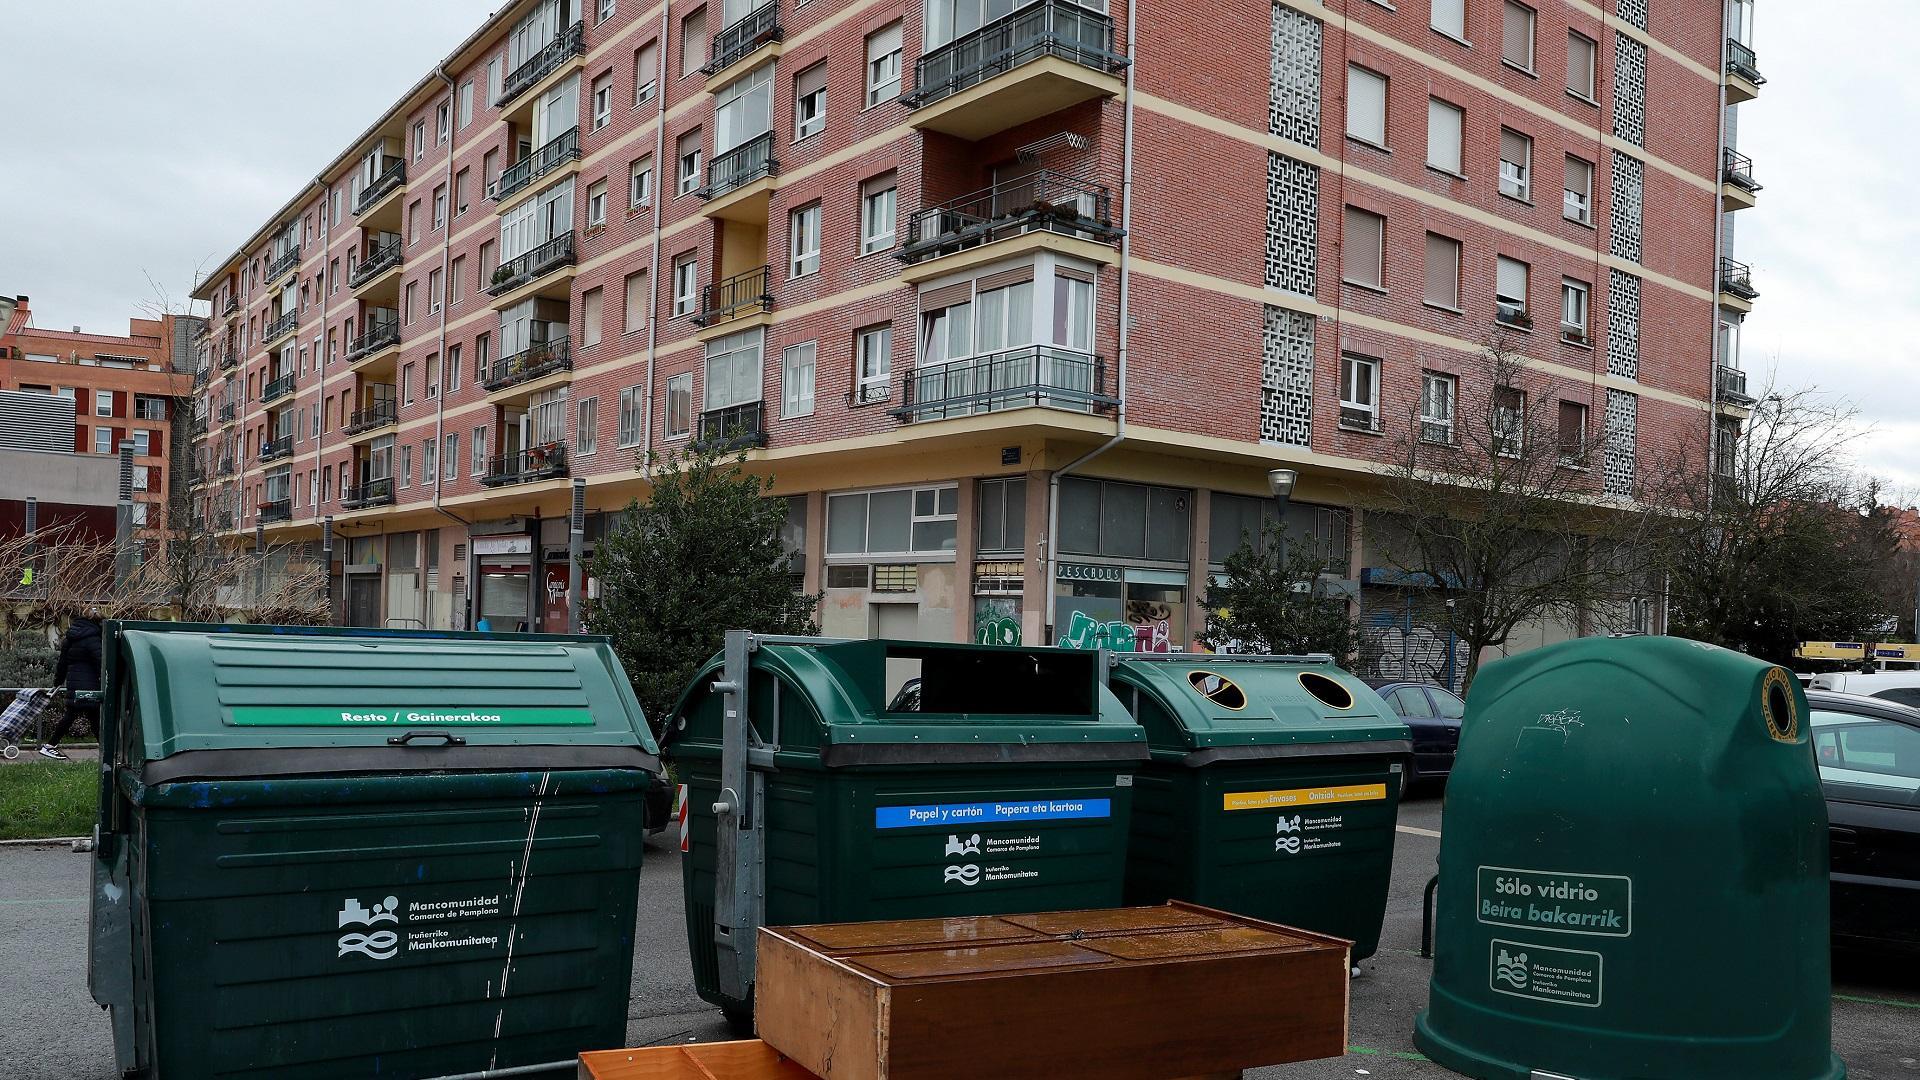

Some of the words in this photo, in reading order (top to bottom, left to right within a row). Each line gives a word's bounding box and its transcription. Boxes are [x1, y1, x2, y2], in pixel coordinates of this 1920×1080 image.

[1058, 565, 1120, 580] PESCADOS
[340, 712, 388, 722] Resto
[406, 712, 501, 722] Gainerakoa
[1269, 794, 1297, 803] Envases
[1308, 789, 1335, 801] Ontziak
[909, 806, 939, 822] Papel
[942, 810, 949, 821] y
[951, 805, 983, 817] cartón
[995, 804, 1030, 817] Papera
[1032, 803, 1047, 813] eta
[1049, 801, 1083, 812] kartoia
[986, 835, 1040, 846] Mancomunidad
[985, 870, 1039, 881] Mankomunitatea
[1495, 876, 1532, 896] Sólo
[1537, 880, 1599, 901] vidrio
[409, 895, 499, 912] Mancomunidad
[409, 913, 445, 921] Comarca
[446, 910, 458, 918] de
[459, 907, 499, 917] Pamplona
[1481, 899, 1522, 920] Beira
[1528, 903, 1623, 928] bakarrik
[408, 929, 449, 940] Iruñerriko
[408, 936, 498, 951] Mankomunitatea
[1532, 963, 1592, 977] Mancomunidad
[1532, 985, 1591, 999] Mankomunitatea
